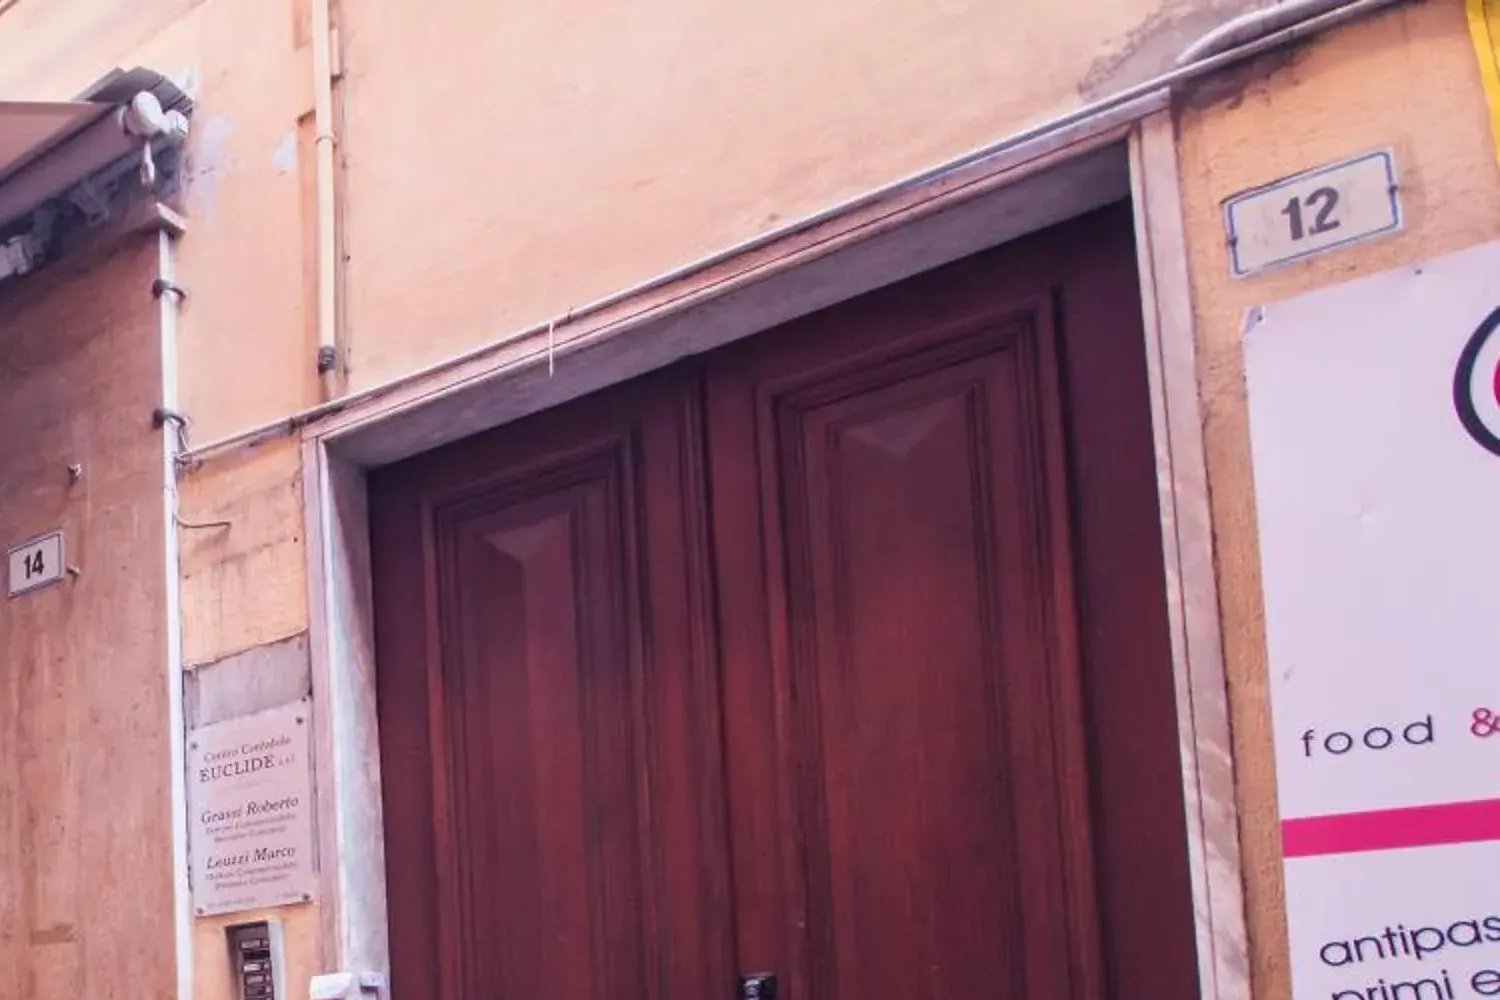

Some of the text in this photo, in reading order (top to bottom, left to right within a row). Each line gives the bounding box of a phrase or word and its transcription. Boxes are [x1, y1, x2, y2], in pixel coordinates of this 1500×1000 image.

[1280, 185, 1341, 241] 12
[23, 548, 45, 580] 14
[1300, 707, 1500, 757] food &
[199, 754, 276, 783] EUCLIDE
[246, 796, 300, 816] Roberto
[253, 847, 296, 863] Marco
[1470, 968, 1500, 998] e
